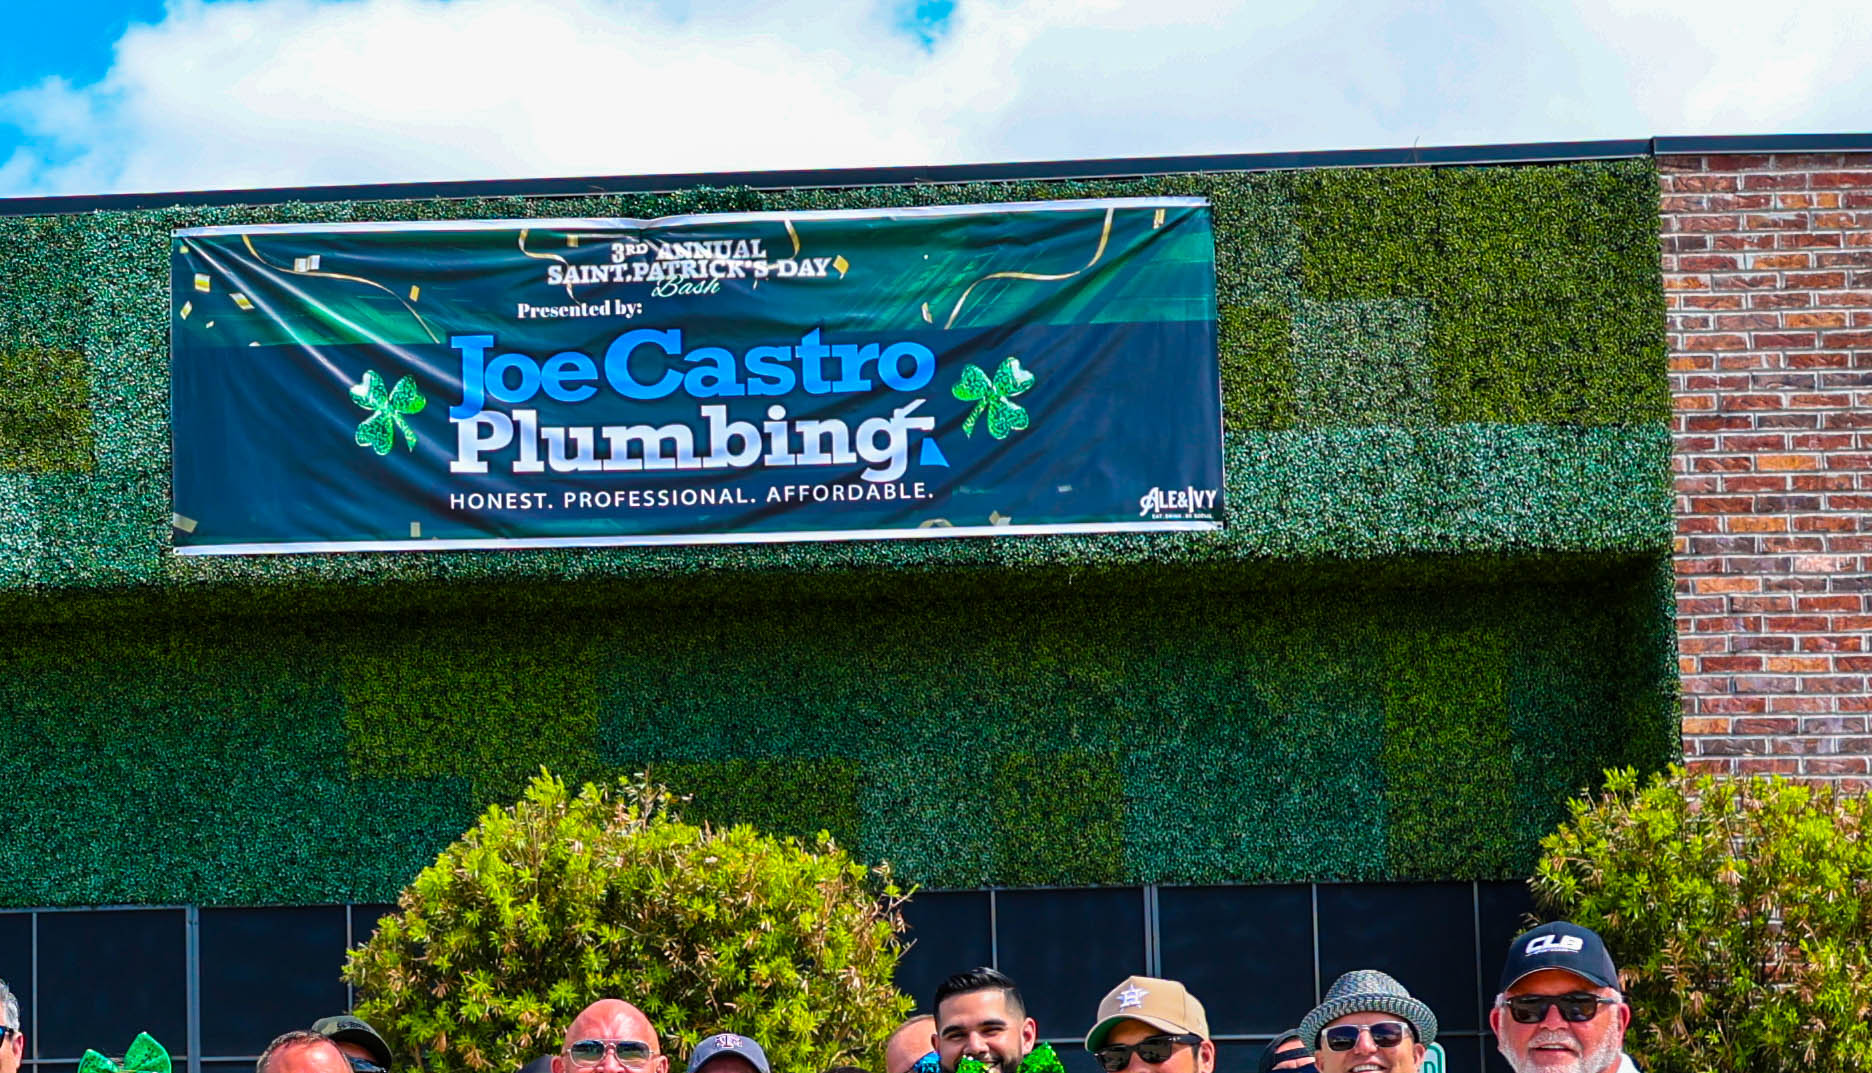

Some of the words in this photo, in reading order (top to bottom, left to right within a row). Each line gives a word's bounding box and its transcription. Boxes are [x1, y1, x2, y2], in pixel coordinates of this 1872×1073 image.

[611, 242, 648, 263] 3RD
[656, 239, 767, 260] ANNUAL
[777, 257, 832, 277] DAY
[651, 275, 721, 297] Bash
[517, 299, 610, 319] Presented
[615, 299, 642, 319] by:
[449, 334, 598, 420] Joe
[604, 327, 936, 400] Castro
[449, 399, 934, 483] Plumbing
[450, 492, 553, 510] HONEST.
[564, 488, 756, 509] PROFESSIONAL.
[766, 482, 934, 502] AFFORDABLE.
